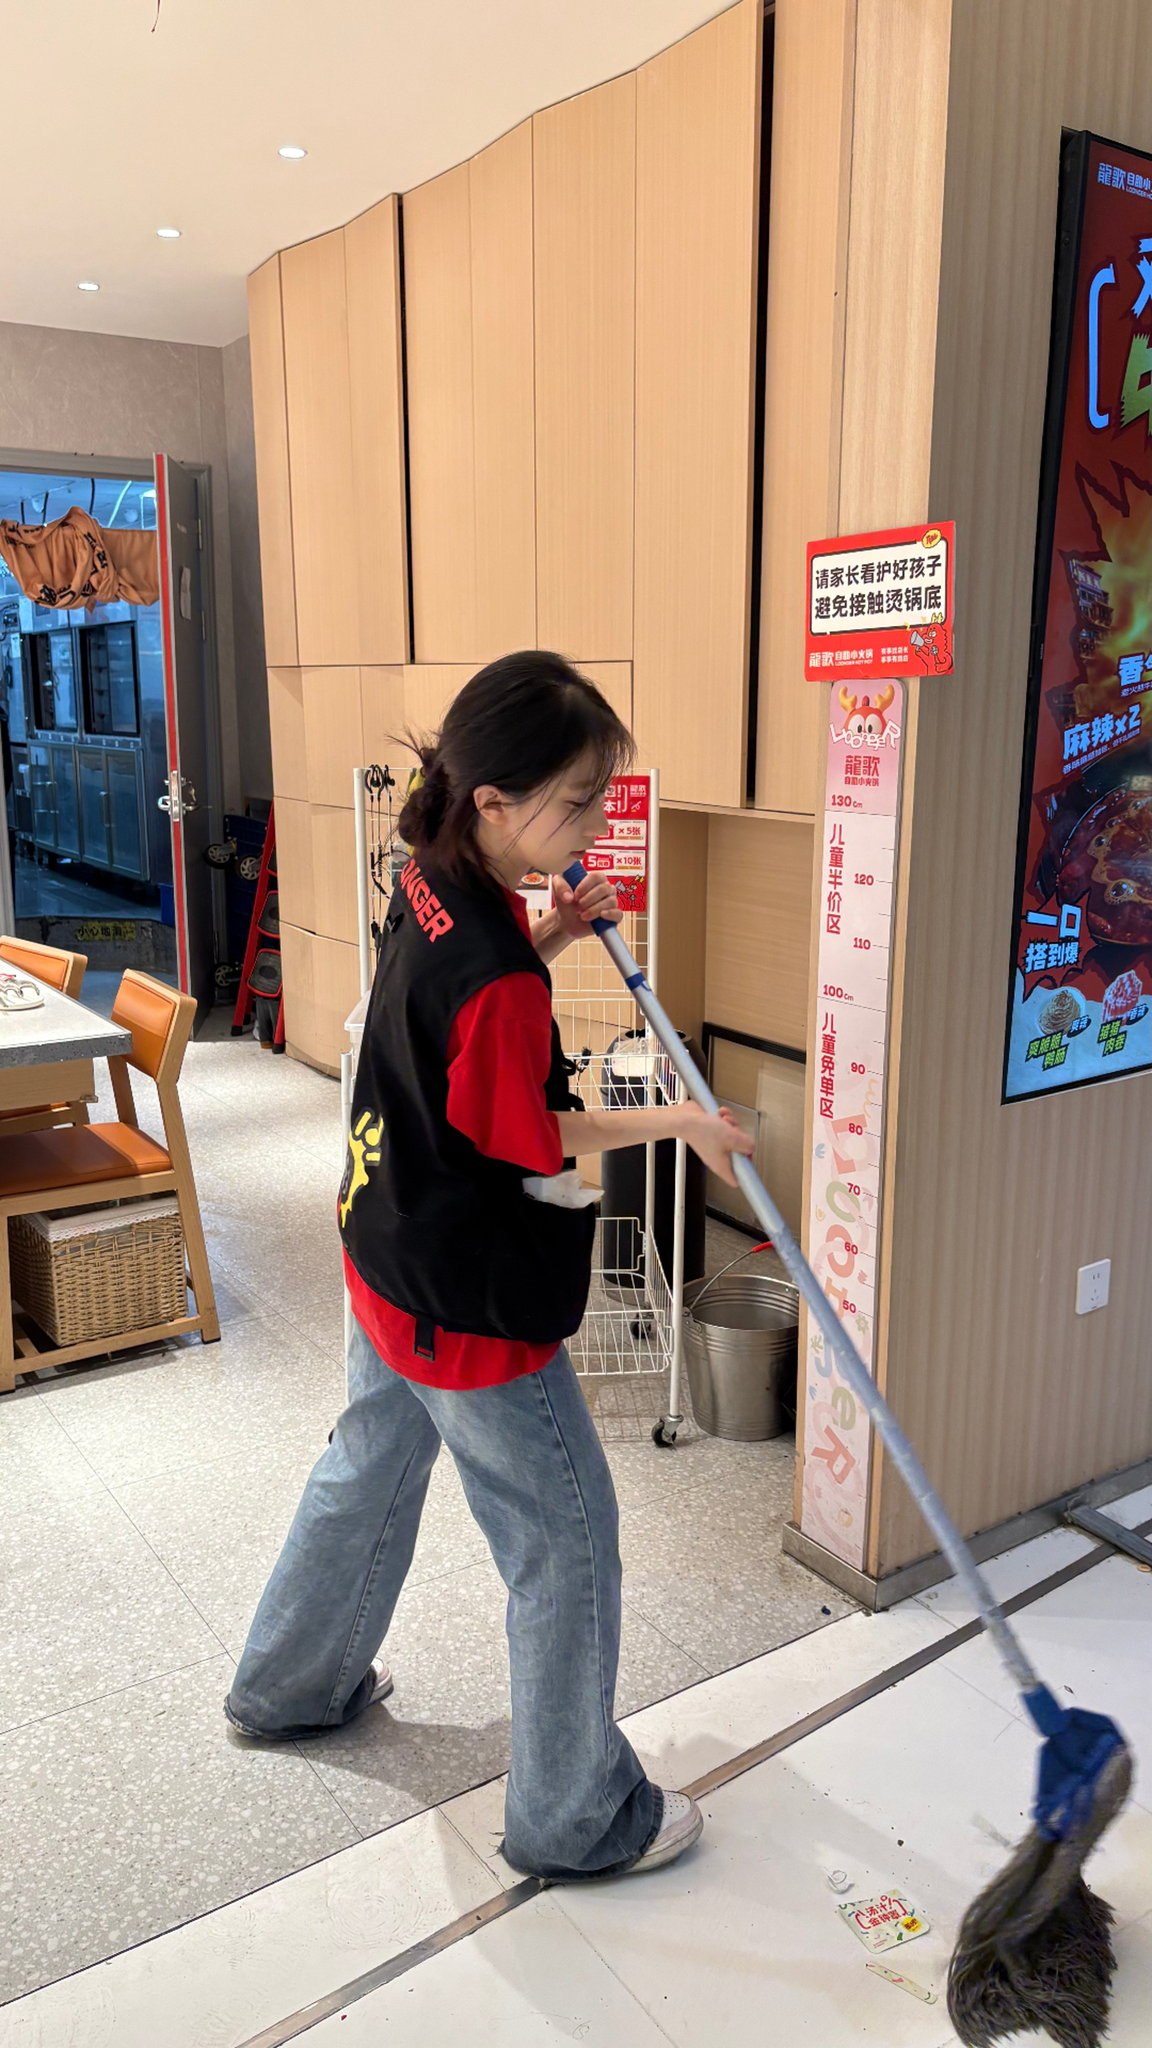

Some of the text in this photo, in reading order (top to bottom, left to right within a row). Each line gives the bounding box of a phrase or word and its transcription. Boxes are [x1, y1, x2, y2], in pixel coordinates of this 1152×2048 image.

[815, 554, 942, 590] 请家长看护好孩子
[814, 585, 942, 619] 避免接触烫锅底
[1119, 653, 1152, 687] 香
[844, 755, 880, 777] 龍歌
[826, 823, 846, 935] 儿童半价区
[854, 873, 874, 886] 120
[1026, 903, 1081, 939] 一口
[853, 937, 871, 950] 110
[1025, 942, 1080, 973] 搭到爆
[819, 1012, 837, 1119] 儿童免单区
[850, 1062, 866, 1075] 90
[848, 1122, 863, 1136] 80
[847, 1182, 861, 1196] 70
[844, 1241, 858, 1255] 60
[842, 1300, 857, 1313] 50
